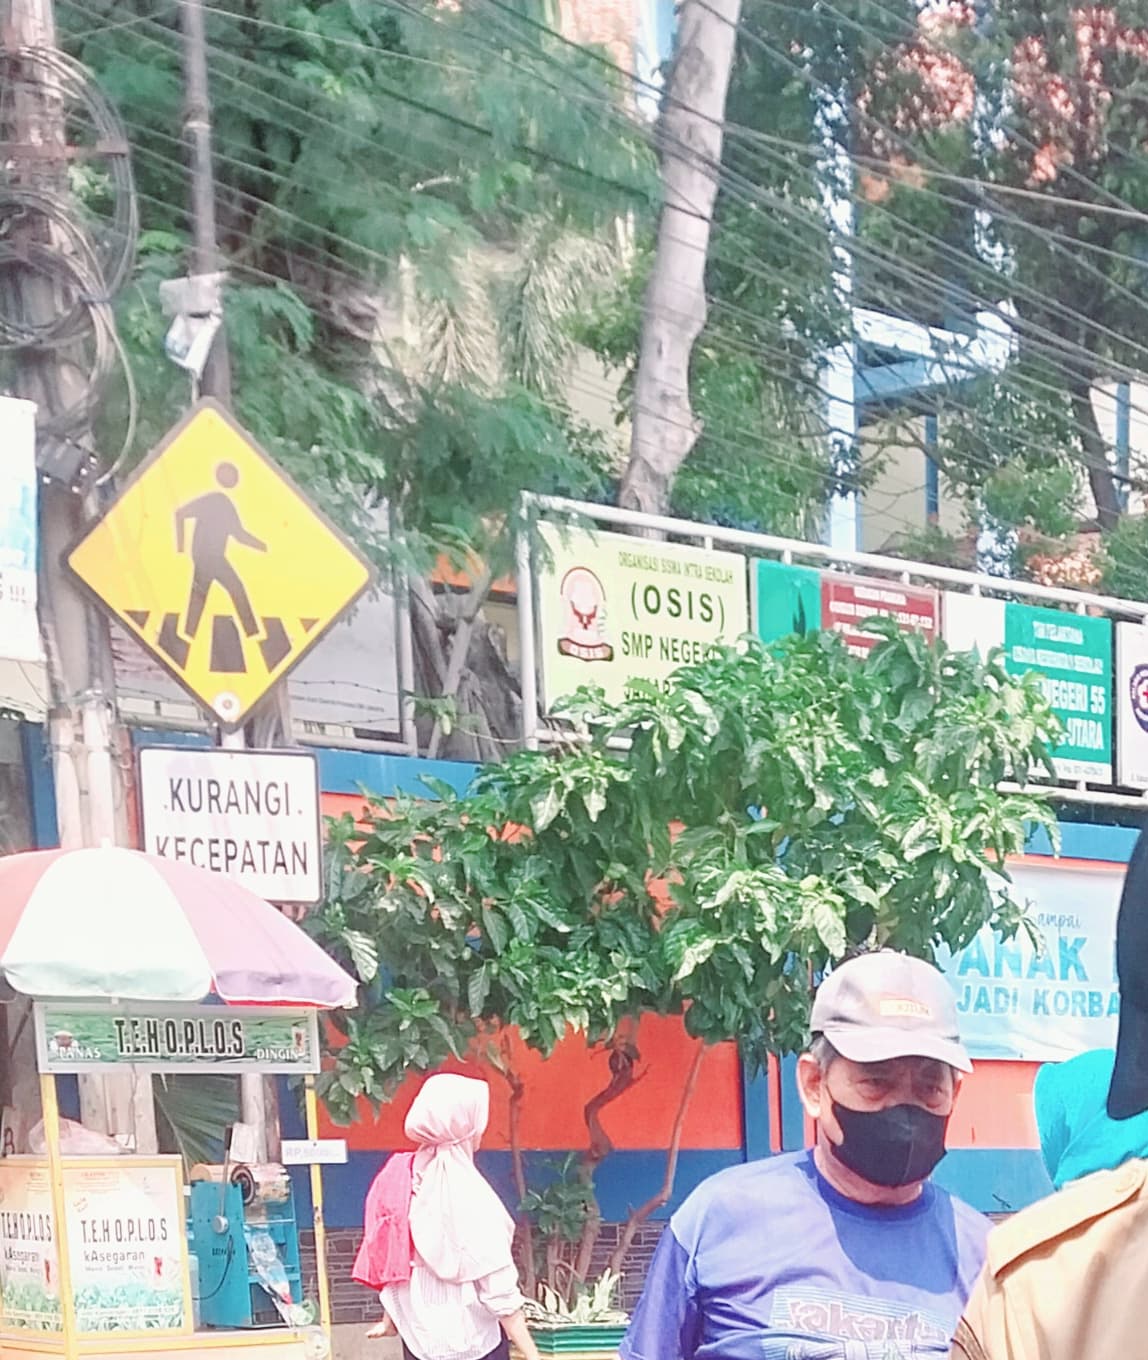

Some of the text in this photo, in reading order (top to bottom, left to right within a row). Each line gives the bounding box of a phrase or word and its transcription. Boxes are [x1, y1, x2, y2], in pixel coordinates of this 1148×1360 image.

[631, 581, 725, 633] (OSIS)
[622, 631, 716, 665] SMP NEGE
[1090, 685, 1106, 714] 55
[169, 777, 290, 816] KURANGI
[155, 834, 308, 875] KECEPATAN
[957, 932, 1089, 982] ANAK
[957, 985, 1120, 1018] JADI KORBA
[256, 1048, 299, 1060] DINGIN
[84, 1250, 145, 1265] kAsegaran
